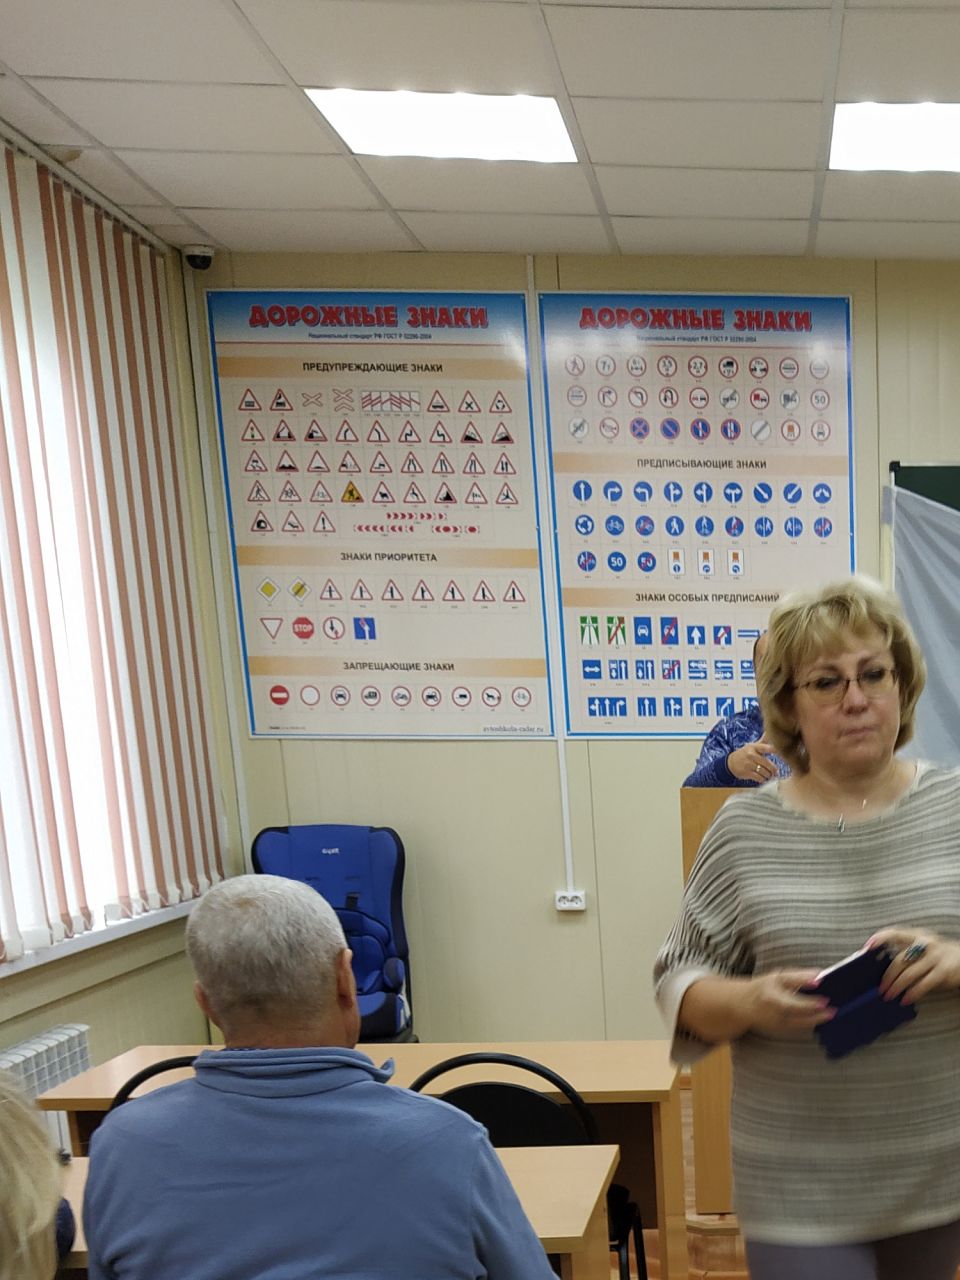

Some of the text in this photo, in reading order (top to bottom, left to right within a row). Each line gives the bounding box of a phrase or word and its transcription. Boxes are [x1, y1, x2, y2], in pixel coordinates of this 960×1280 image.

[249, 304, 489, 329] ДОРОЖНЫЕ ЗНАКИ
[579, 306, 812, 332] ДОРОЖНЫЕ ЗНАКИ
[303, 362, 443, 373] ПРЕДУПРЕЖДАЮЩИЕ ЗНАКИ
[637, 458, 767, 470] ПРЕДПИСЫВАЮЩИЕ ЗНАКИ
[341, 552, 437, 563] ЗНАКИ ПРИОРИТЕТА
[611, 557, 623, 567] 50
[635, 593, 780, 604] ЗНАКИ ОСОБЫХ ПРЕДПИСАНИЙ
[343, 662, 455, 673] ЗАПРЕЩАЮЩИЕ ЗНАКИ
